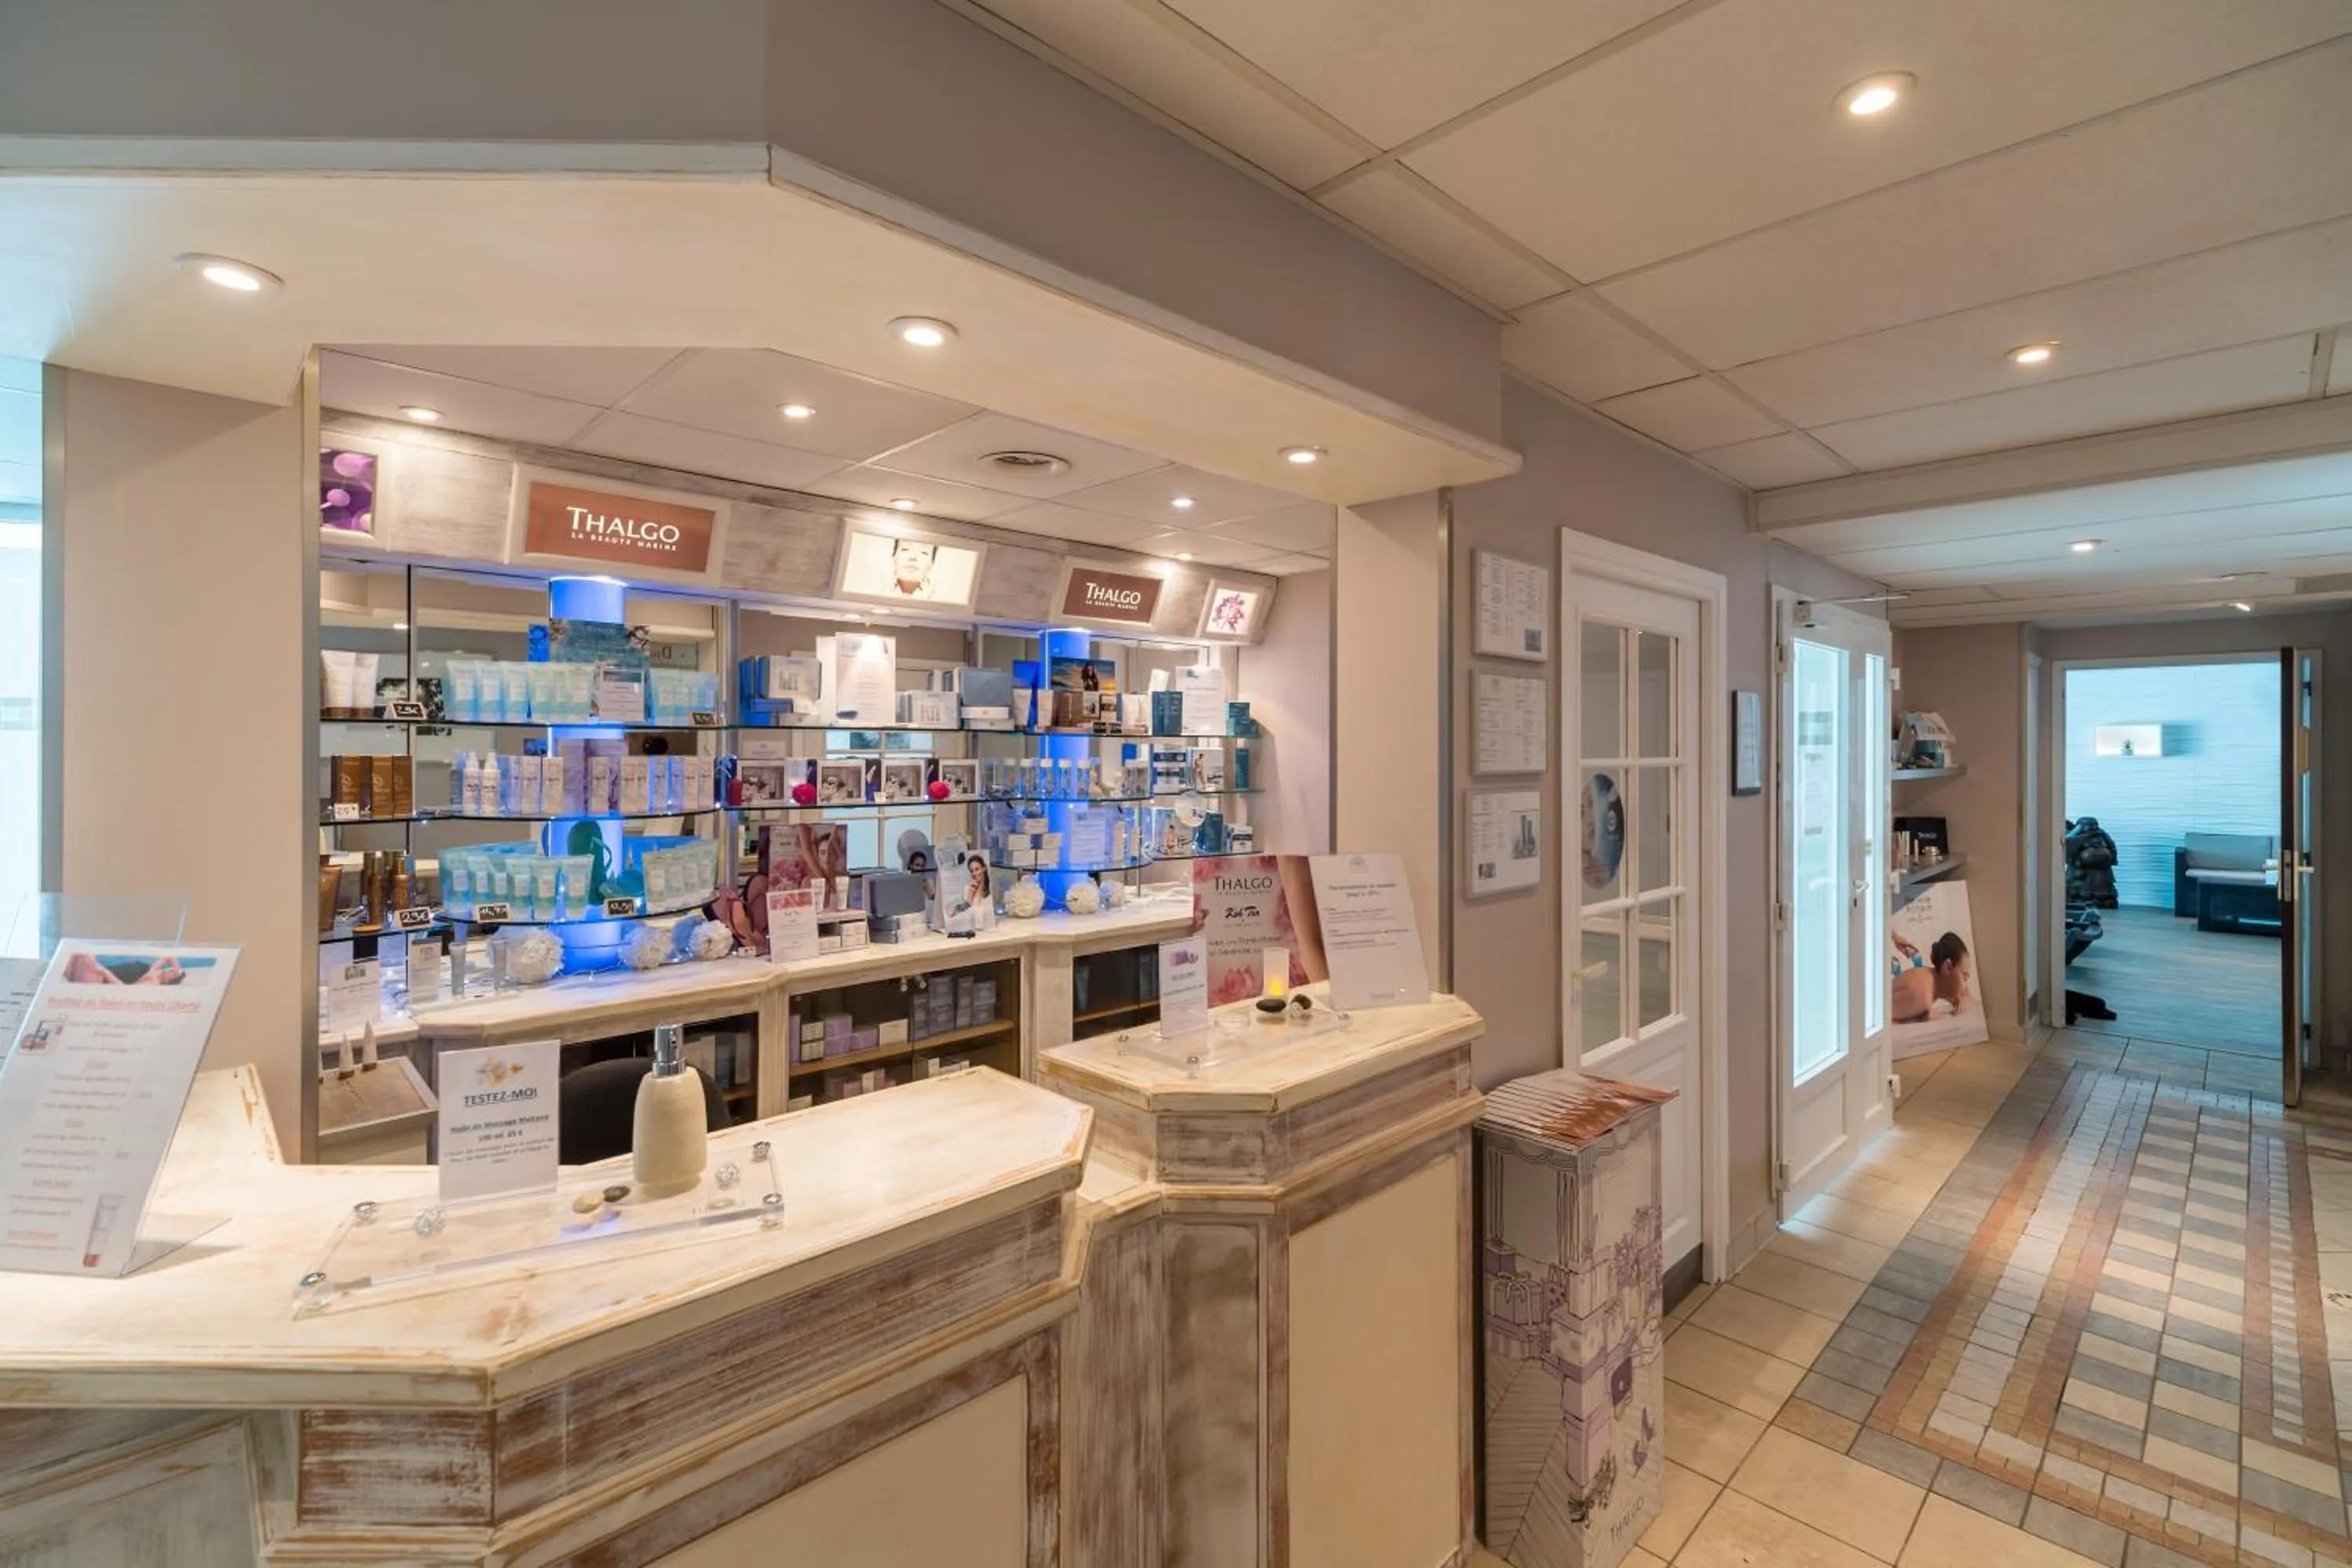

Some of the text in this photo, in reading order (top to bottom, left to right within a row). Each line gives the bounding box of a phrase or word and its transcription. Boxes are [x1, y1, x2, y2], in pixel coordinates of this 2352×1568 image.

[566, 506, 680, 543] THALGO
[637, 540, 677, 551] MARINE
[1086, 583, 1142, 604] THALGO
[1212, 875, 1272, 891] THALGO
[463, 1087, 538, 1105] TESTEZ-MOI
[1610, 1494, 1645, 1544] THALGO
